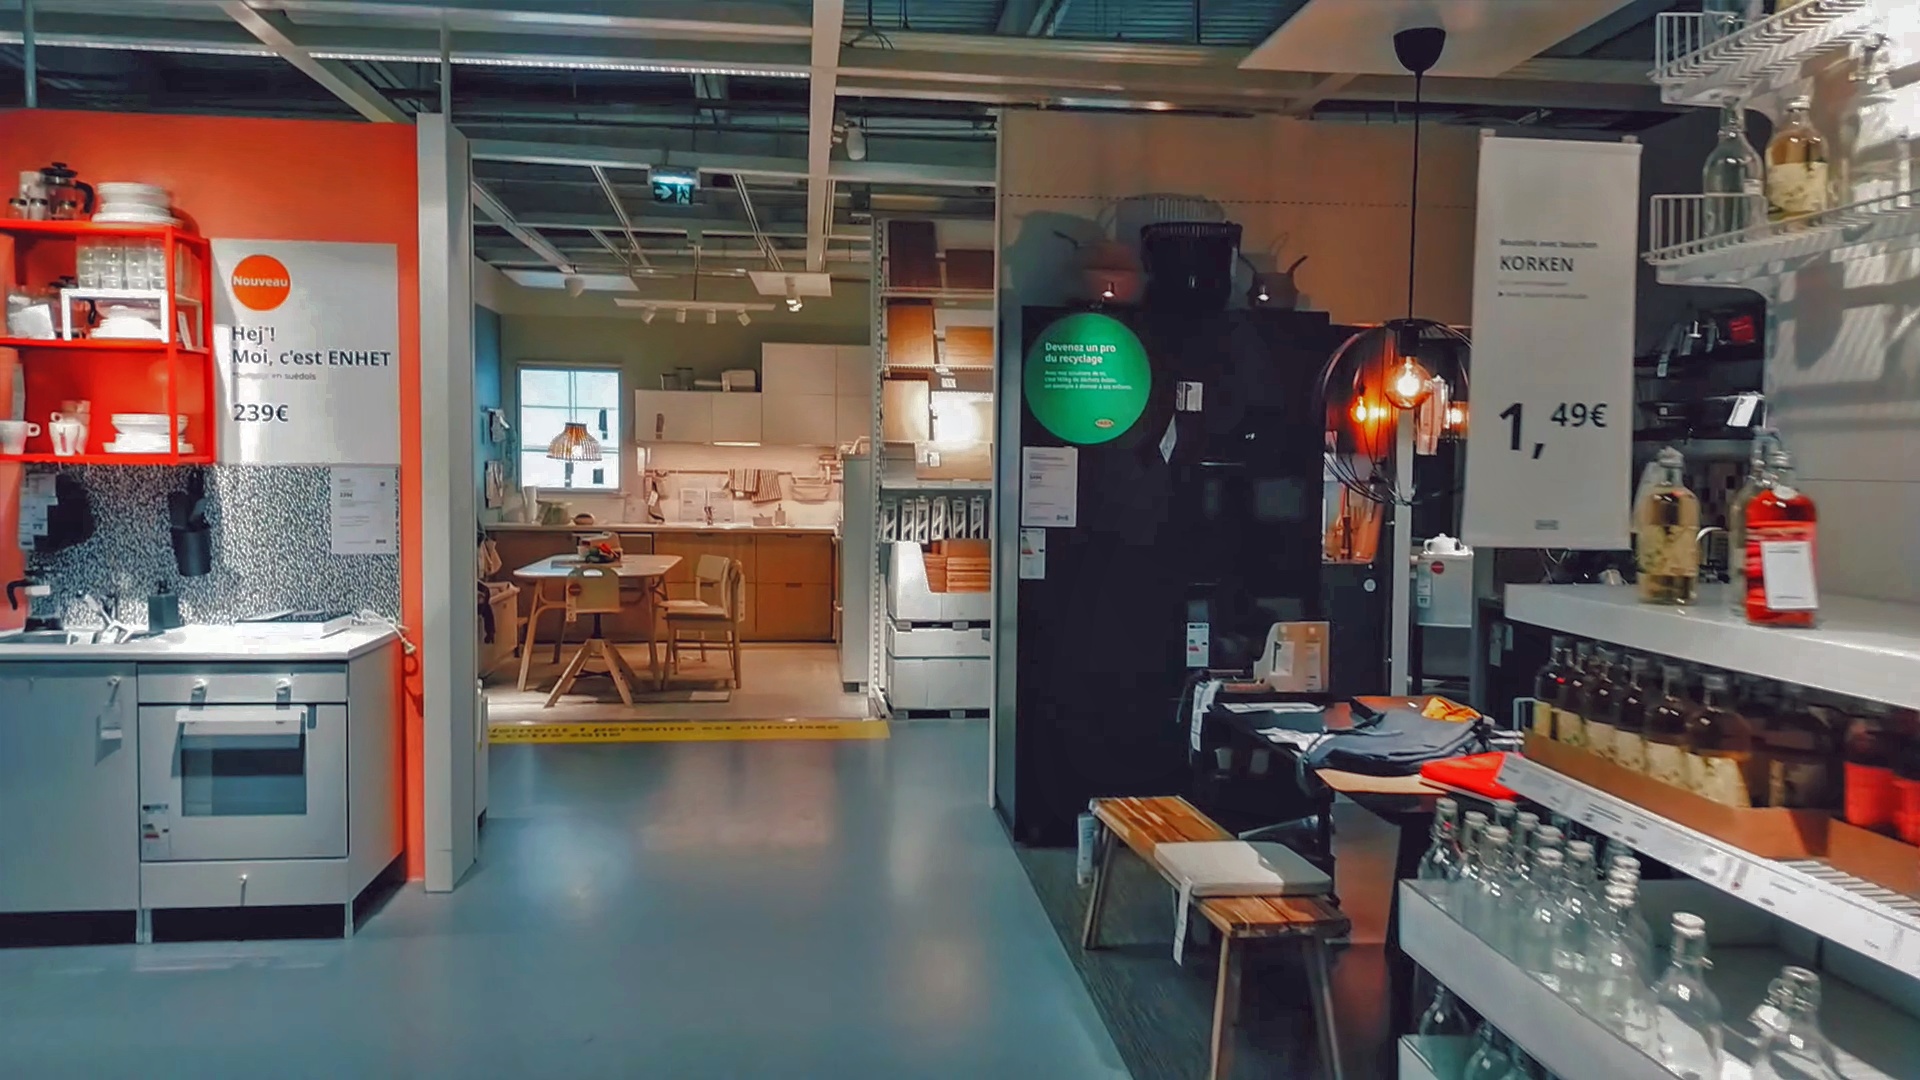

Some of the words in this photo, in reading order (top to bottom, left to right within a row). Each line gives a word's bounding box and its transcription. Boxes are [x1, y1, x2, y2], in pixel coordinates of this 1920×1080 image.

[1499, 255, 1574, 272] KORKEN
[232, 276, 289, 288] Nouveau
[1044, 342, 1085, 352] Devenez
[1086, 344, 1099, 352] un
[1099, 344, 1117, 355] pro
[231, 349, 274, 367] Moi,
[279, 349, 324, 366] c'est
[328, 350, 392, 367] ENHET
[1044, 354, 1058, 363] du
[1059, 354, 1104, 365] recyclage
[232, 403, 289, 422] 239€
